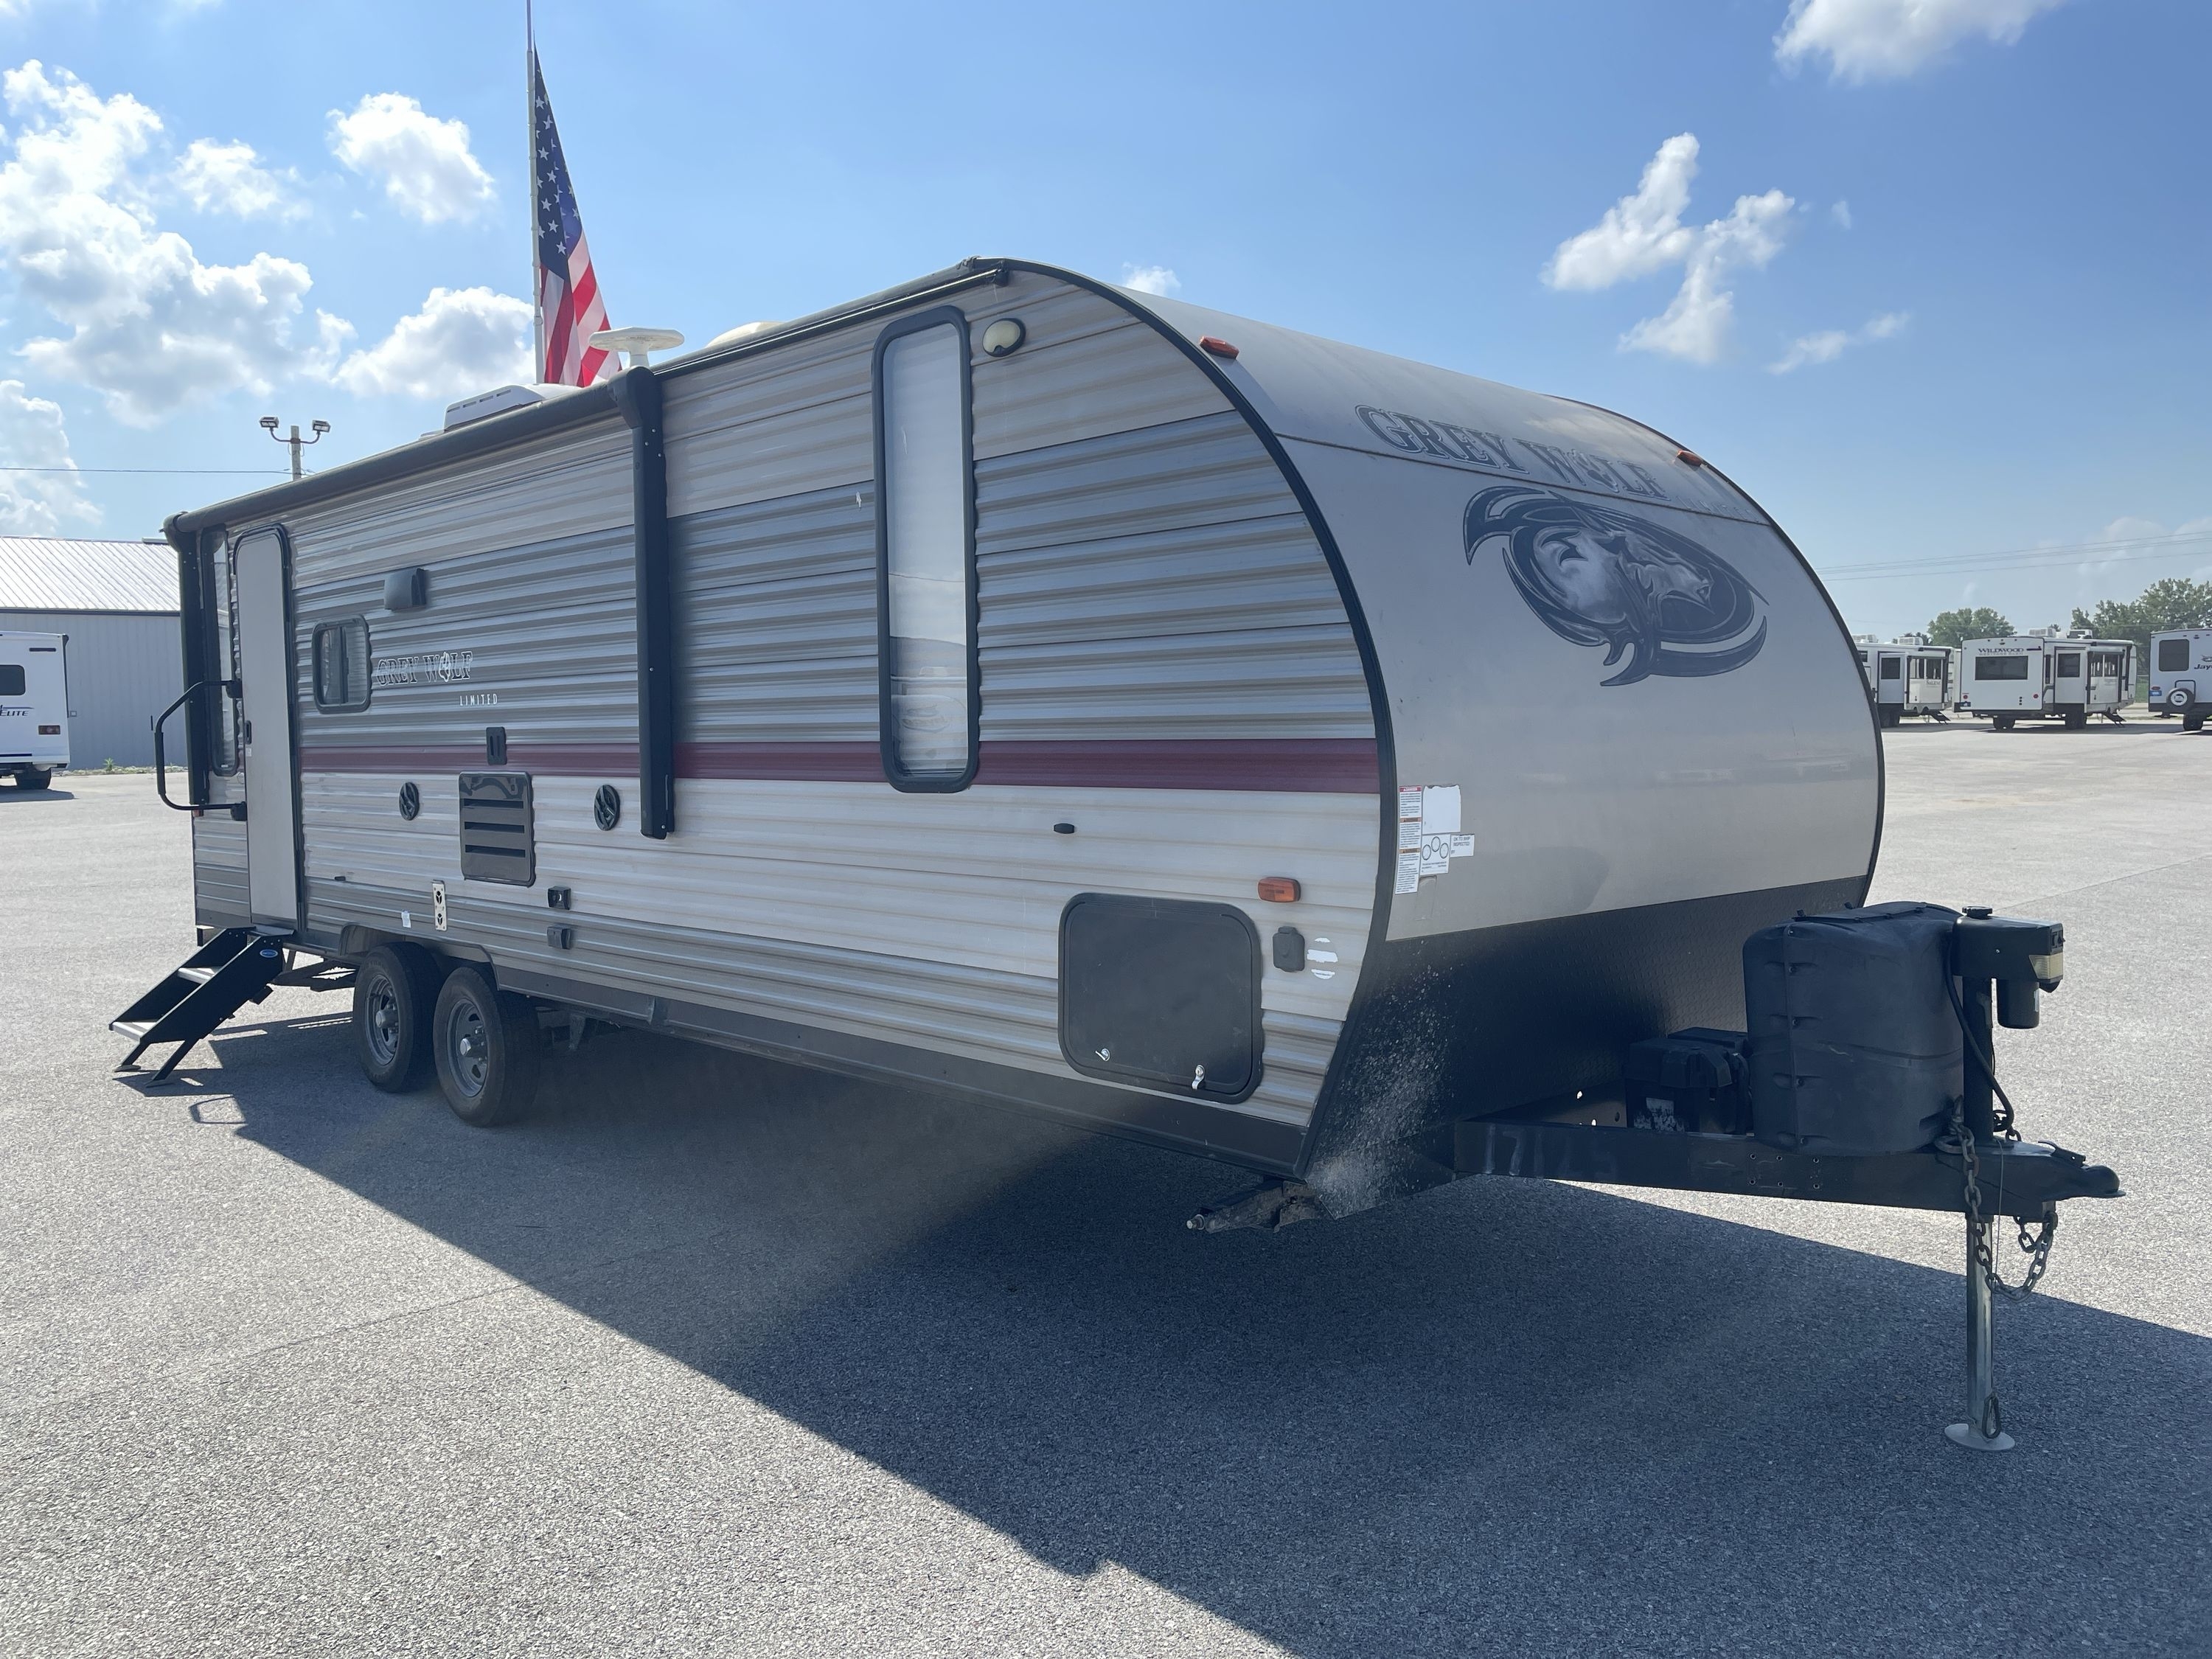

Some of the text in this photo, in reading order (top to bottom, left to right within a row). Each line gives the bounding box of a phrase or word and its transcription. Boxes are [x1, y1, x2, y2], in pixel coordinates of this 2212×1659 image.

[1354, 404, 1530, 474] GREY
[376, 656, 419, 686] GREY
[459, 693, 498, 706] LIMITED
